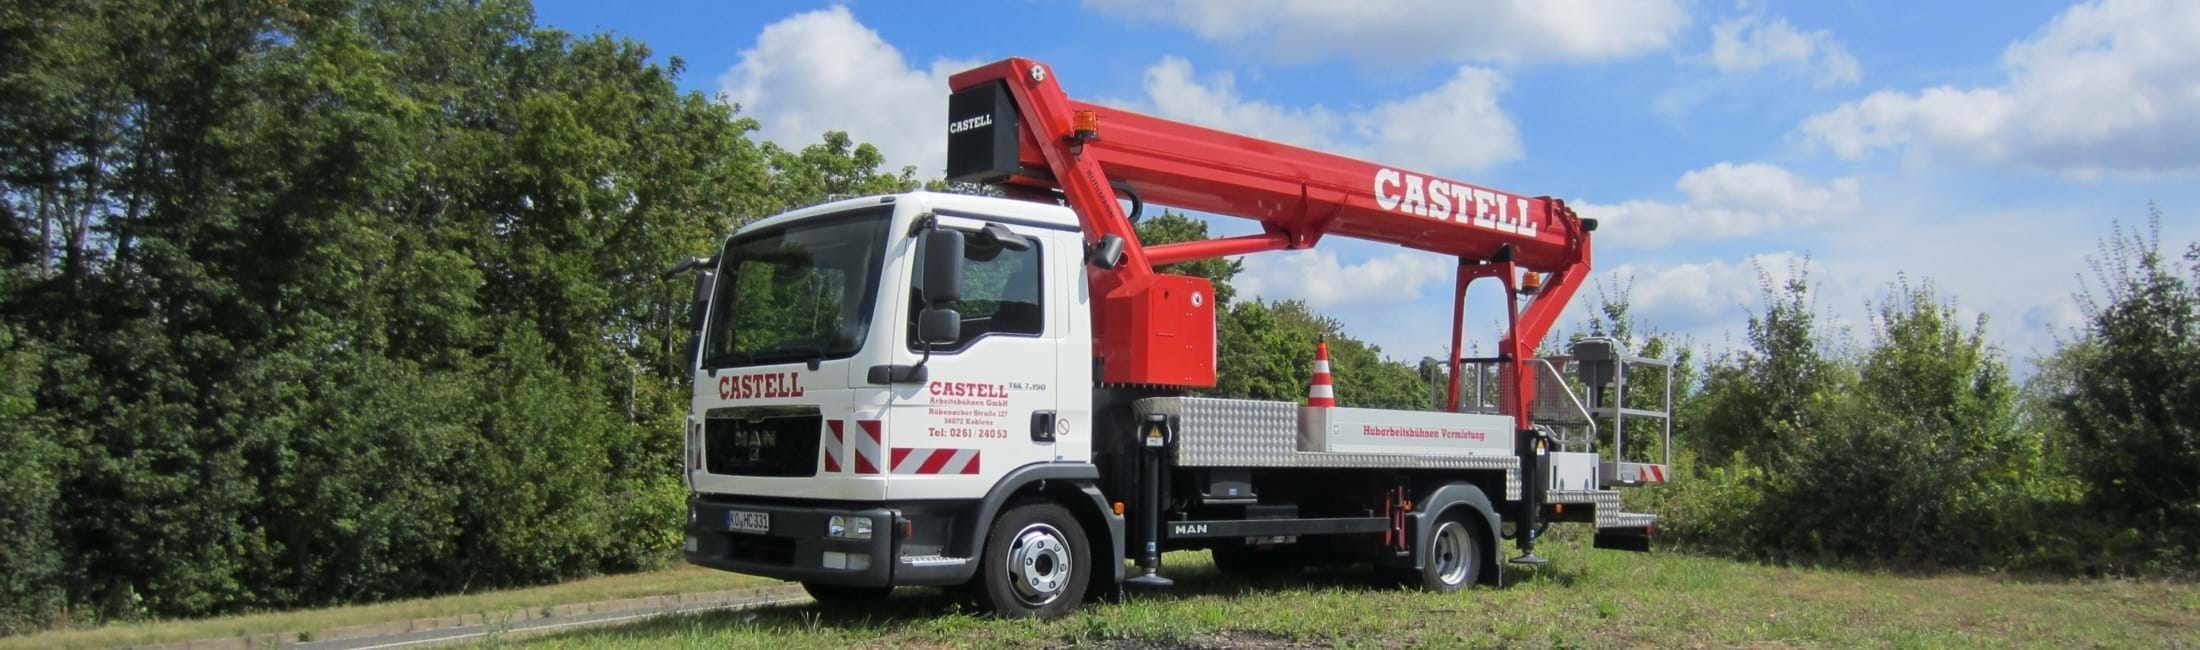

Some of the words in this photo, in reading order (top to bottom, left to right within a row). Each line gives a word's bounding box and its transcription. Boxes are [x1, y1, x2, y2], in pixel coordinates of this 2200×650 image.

[950, 113, 992, 134] CASTELL
[1374, 168, 1537, 237] CASTELL
[719, 371, 804, 400] CASTELL
[929, 381, 1008, 398] CASTELL
[986, 399, 1008, 407] GmbH
[735, 430, 776, 448] MAN
[928, 427, 947, 437] Tel:
[1363, 425, 1439, 439] Hubarbeitsbühnen
[1441, 428, 1485, 442] Vermietung
[1175, 524, 1207, 535] MAN
